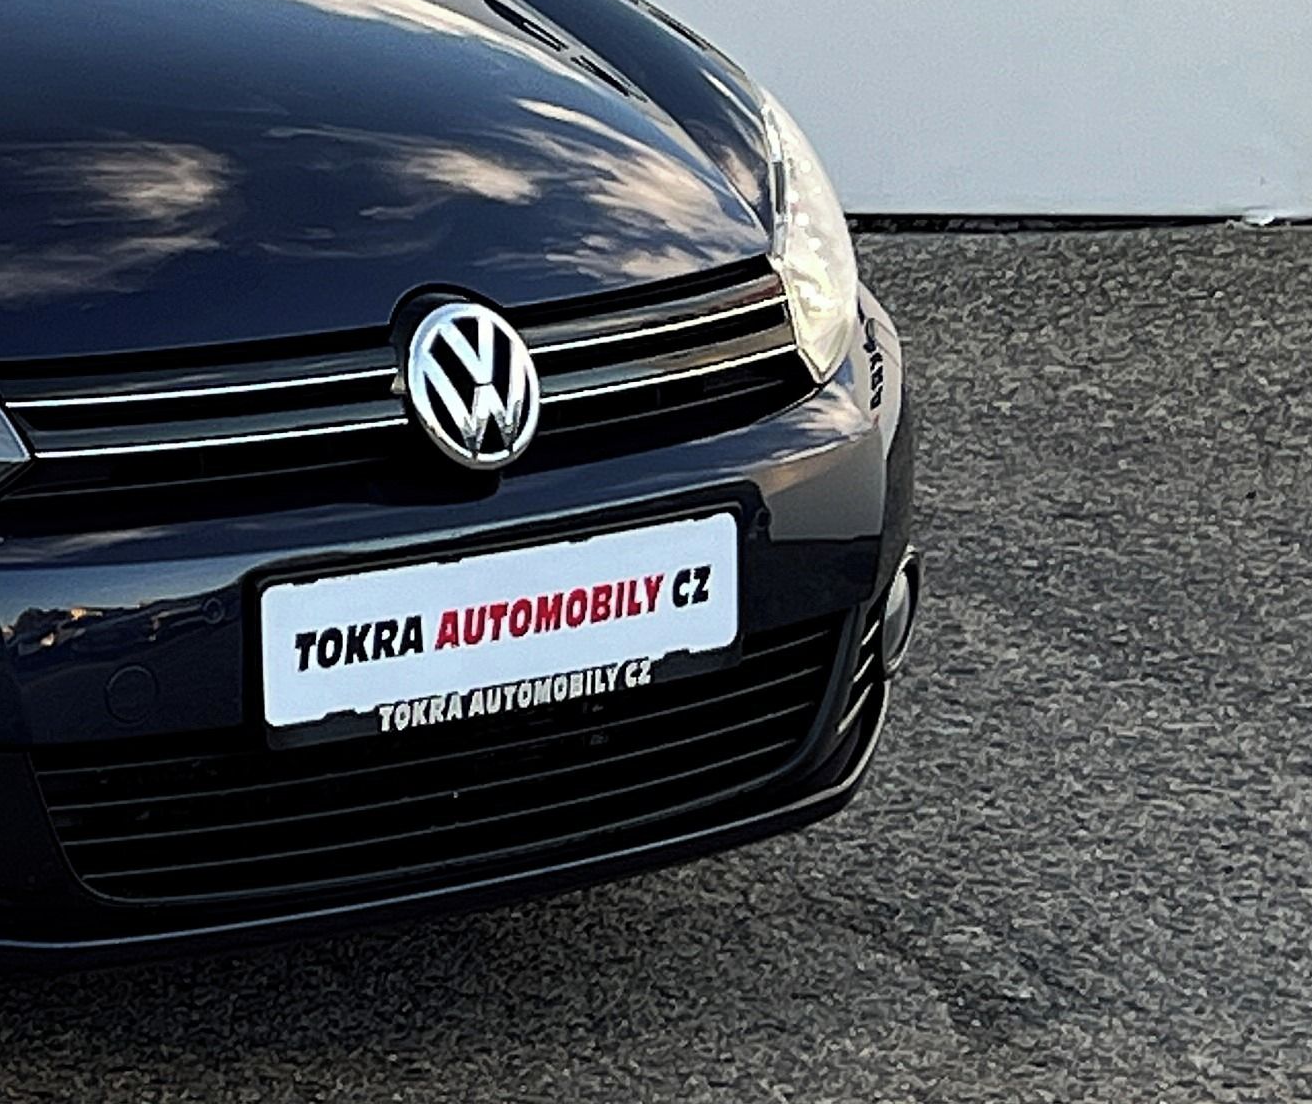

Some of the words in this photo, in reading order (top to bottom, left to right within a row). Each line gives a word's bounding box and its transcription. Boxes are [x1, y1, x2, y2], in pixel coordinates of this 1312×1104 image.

[411, 307, 537, 466] VW
[294, 615, 424, 672] TOKRA
[435, 574, 664, 651] AUTOMOBILY
[672, 565, 711, 608] CZ
[378, 695, 463, 732] TOKRA
[468, 667, 619, 718] AUTOMOBILY
[624, 660, 652, 688] CZ
